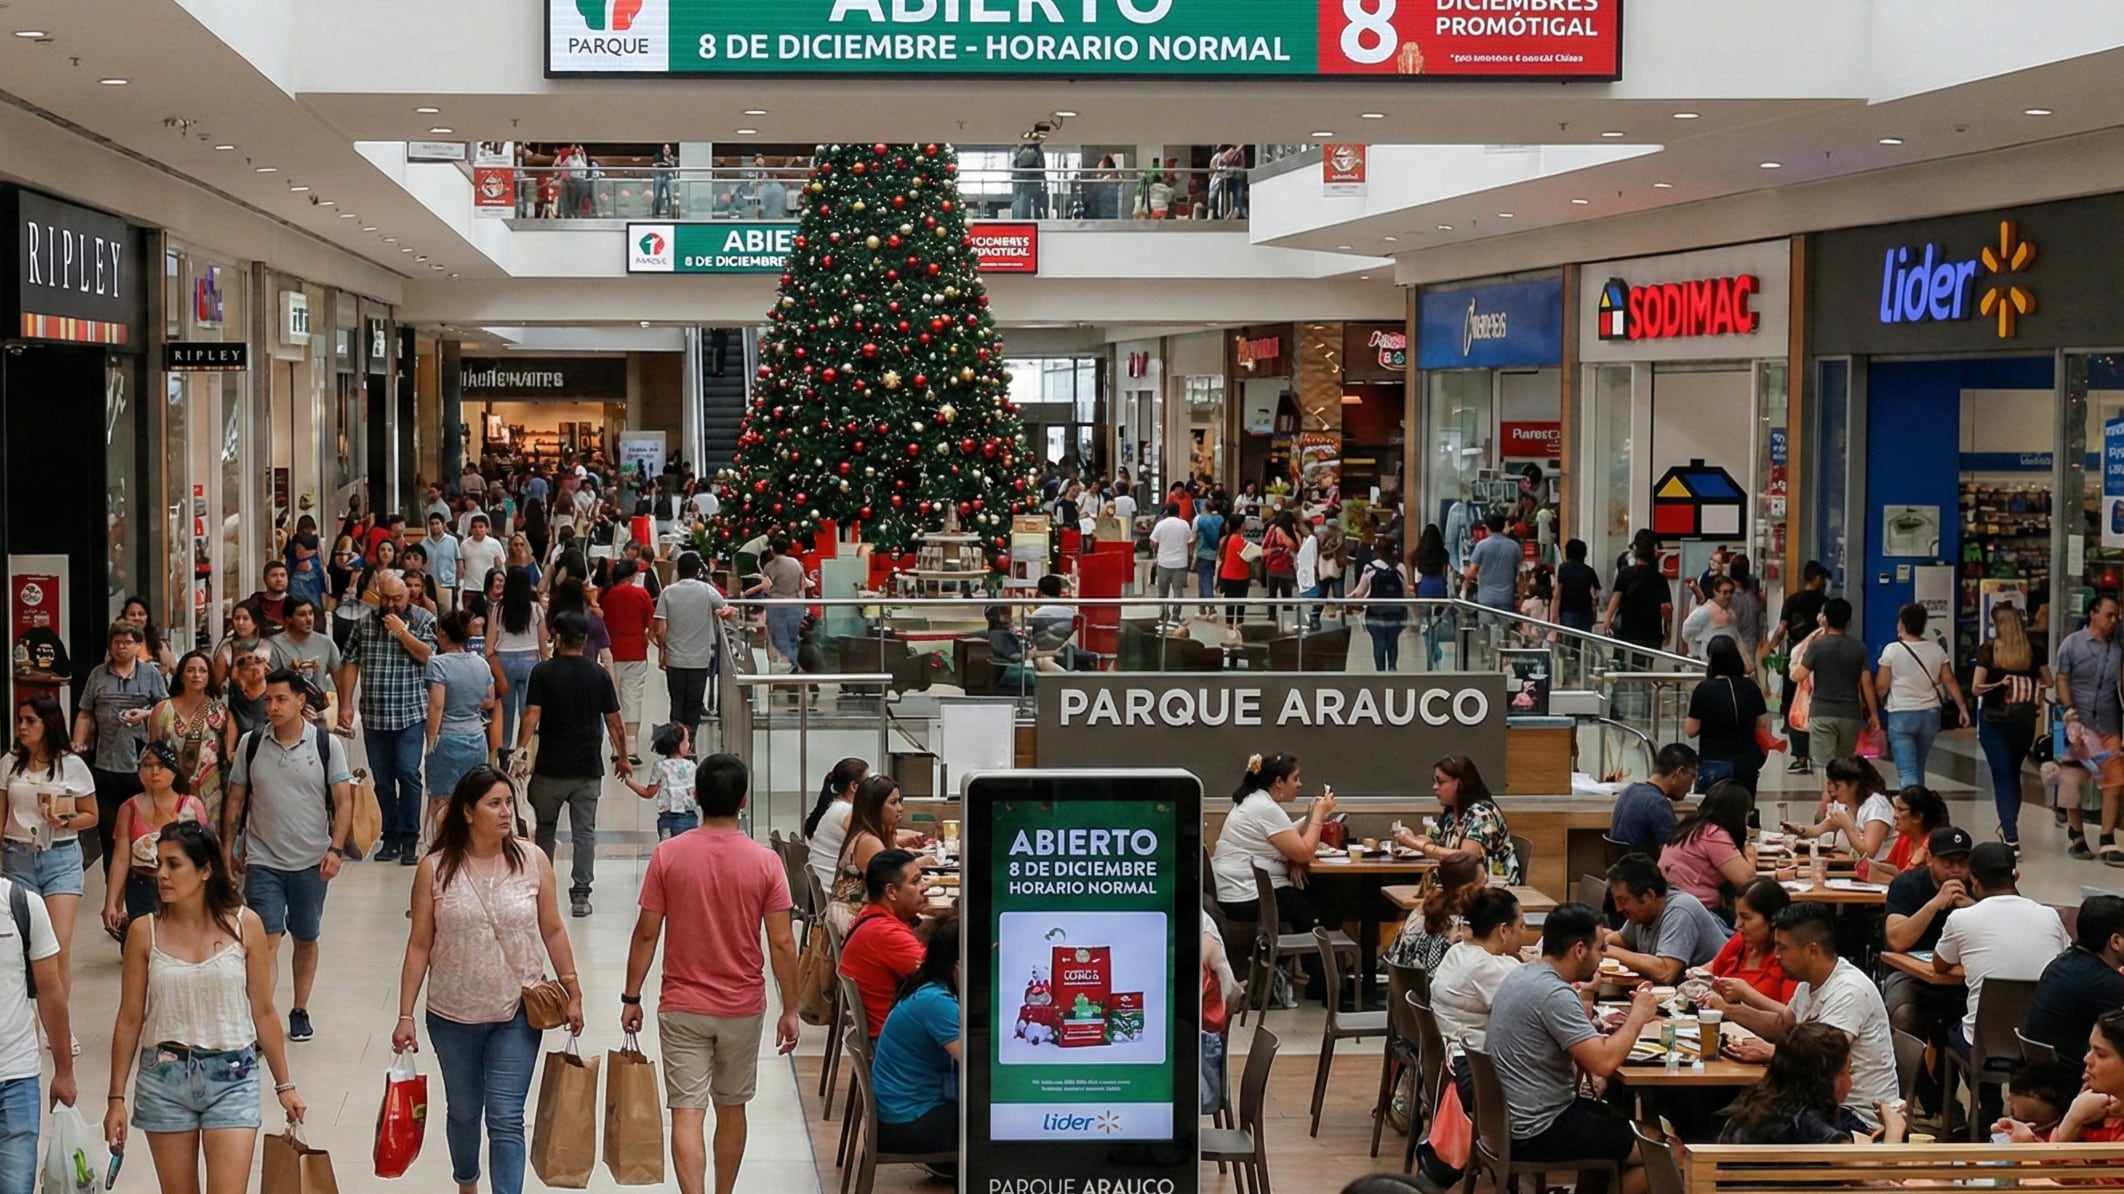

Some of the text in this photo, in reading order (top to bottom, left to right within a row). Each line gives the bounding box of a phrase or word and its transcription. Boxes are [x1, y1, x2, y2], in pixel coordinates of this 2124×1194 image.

[1436, 12, 1598, 36] PROMÓTIGAL
[569, 38, 649, 57] PARQUE
[698, 34, 717, 60] 8
[727, 35, 769, 59] DE
[779, 35, 957, 60] DICIEMBRE
[986, 35, 1139, 61] HORARIO
[1148, 36, 1291, 61] NORMAL
[27, 221, 122, 298] RIPLEY
[695, 256, 713, 267] DE
[1880, 243, 1978, 323] lider
[1629, 274, 1757, 341] SODIMAC
[174, 350, 241, 361] RIPLEY
[1060, 688, 1488, 726] PARQUE ARAUCO
[1009, 829, 1158, 856] ABIERTO
[1009, 861, 1157, 877] 8 DE DICIEMBRE
[1009, 881, 1157, 895] HORARIO NORMAL
[1043, 1113, 1095, 1131] lider
